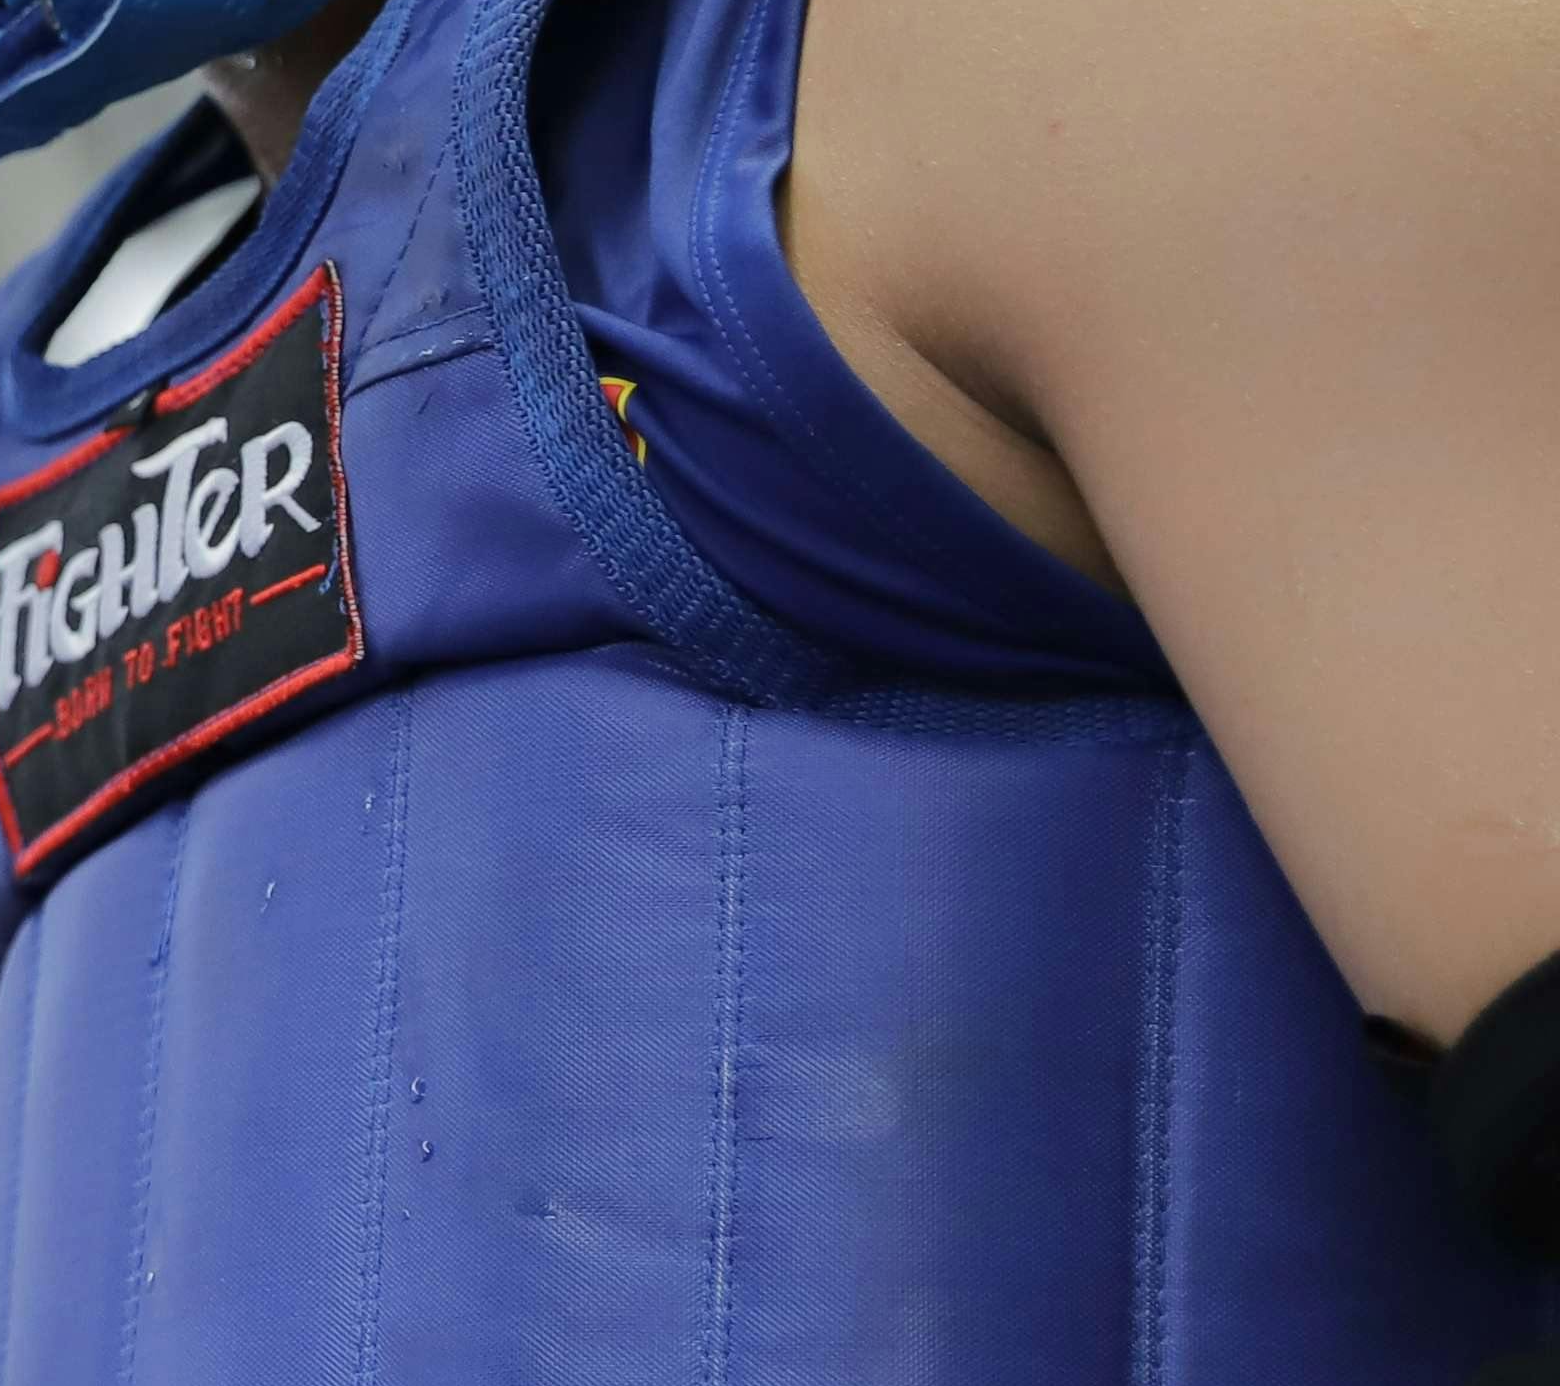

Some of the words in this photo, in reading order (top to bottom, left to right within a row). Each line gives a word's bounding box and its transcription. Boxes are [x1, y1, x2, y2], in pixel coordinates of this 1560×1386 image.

[54, 666, 113, 741] BORN
[123, 641, 156, 691] TO
[161, 587, 245, 667] FIGHT
